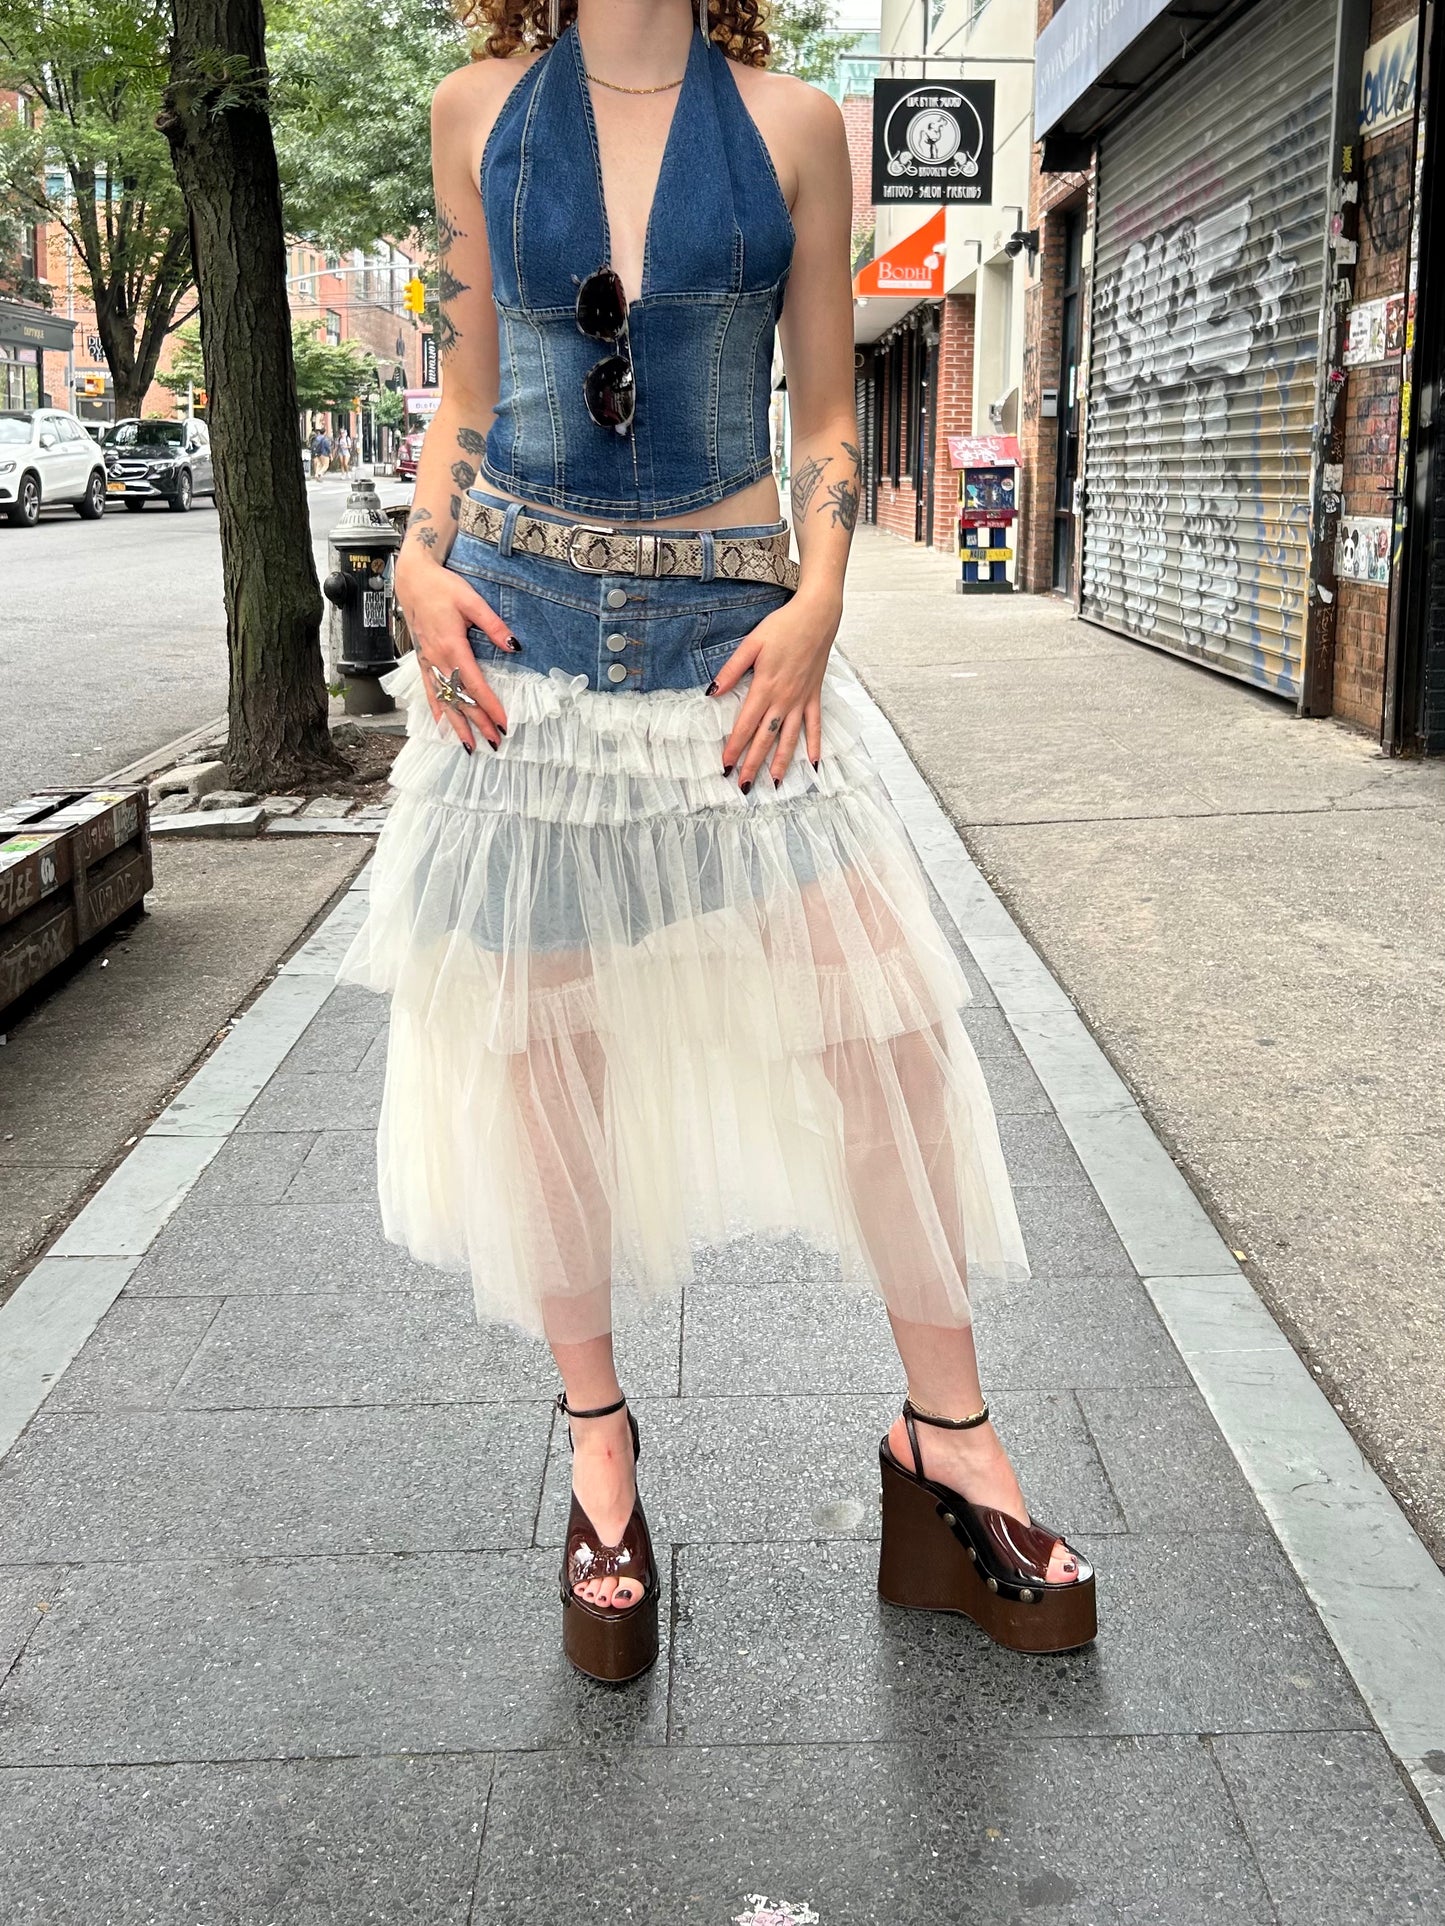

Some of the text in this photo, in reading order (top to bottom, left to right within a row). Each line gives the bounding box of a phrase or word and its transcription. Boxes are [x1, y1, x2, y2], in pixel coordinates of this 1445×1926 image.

[883, 185, 914, 198] TATTOOS
[919, 185, 942, 199] SALON
[879, 261, 932, 280] BODHI
